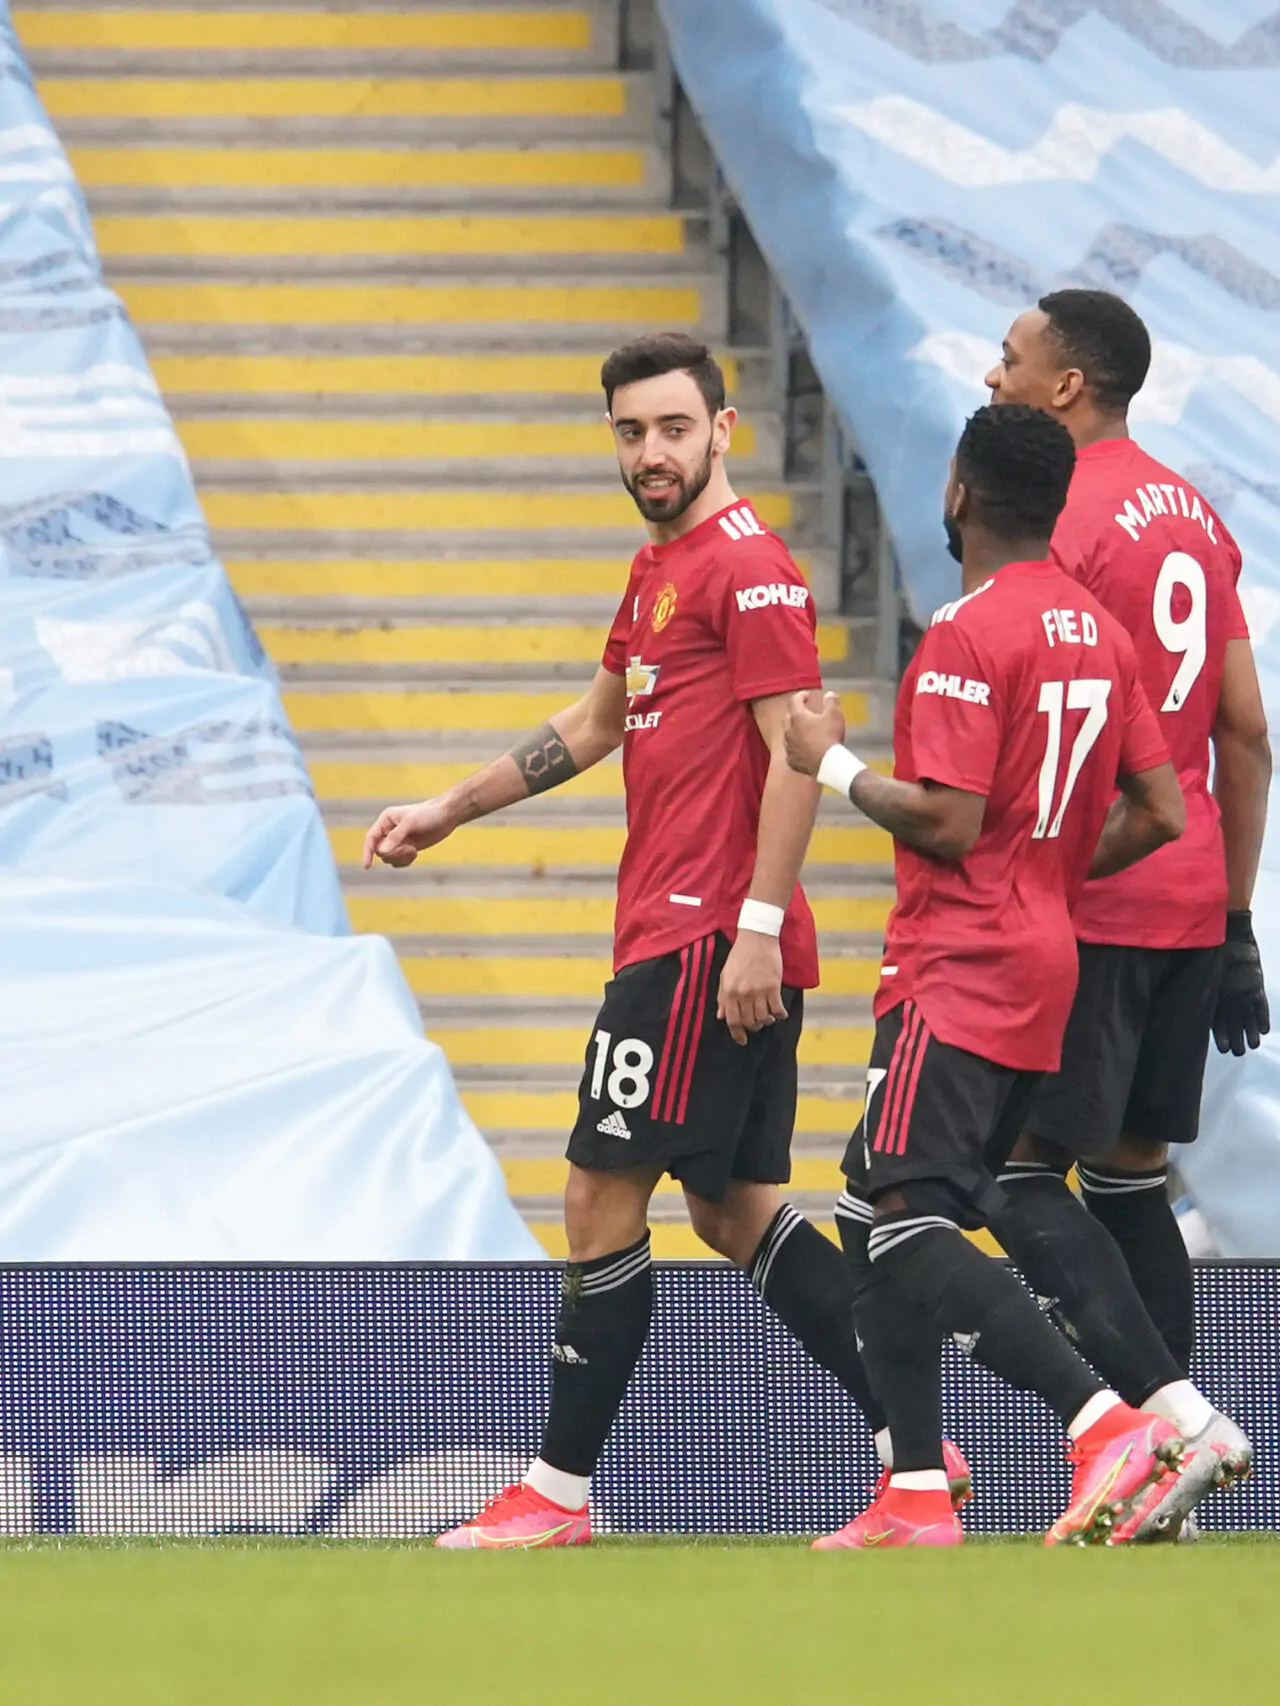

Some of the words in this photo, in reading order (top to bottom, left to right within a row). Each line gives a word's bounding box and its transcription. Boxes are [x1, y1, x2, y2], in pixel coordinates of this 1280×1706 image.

[735, 583, 810, 612] KOHLER
[1152, 551, 1207, 712] 9
[623, 711, 663, 732] OLET
[1031, 677, 1112, 839] 17
[589, 1028, 655, 1110] 18
